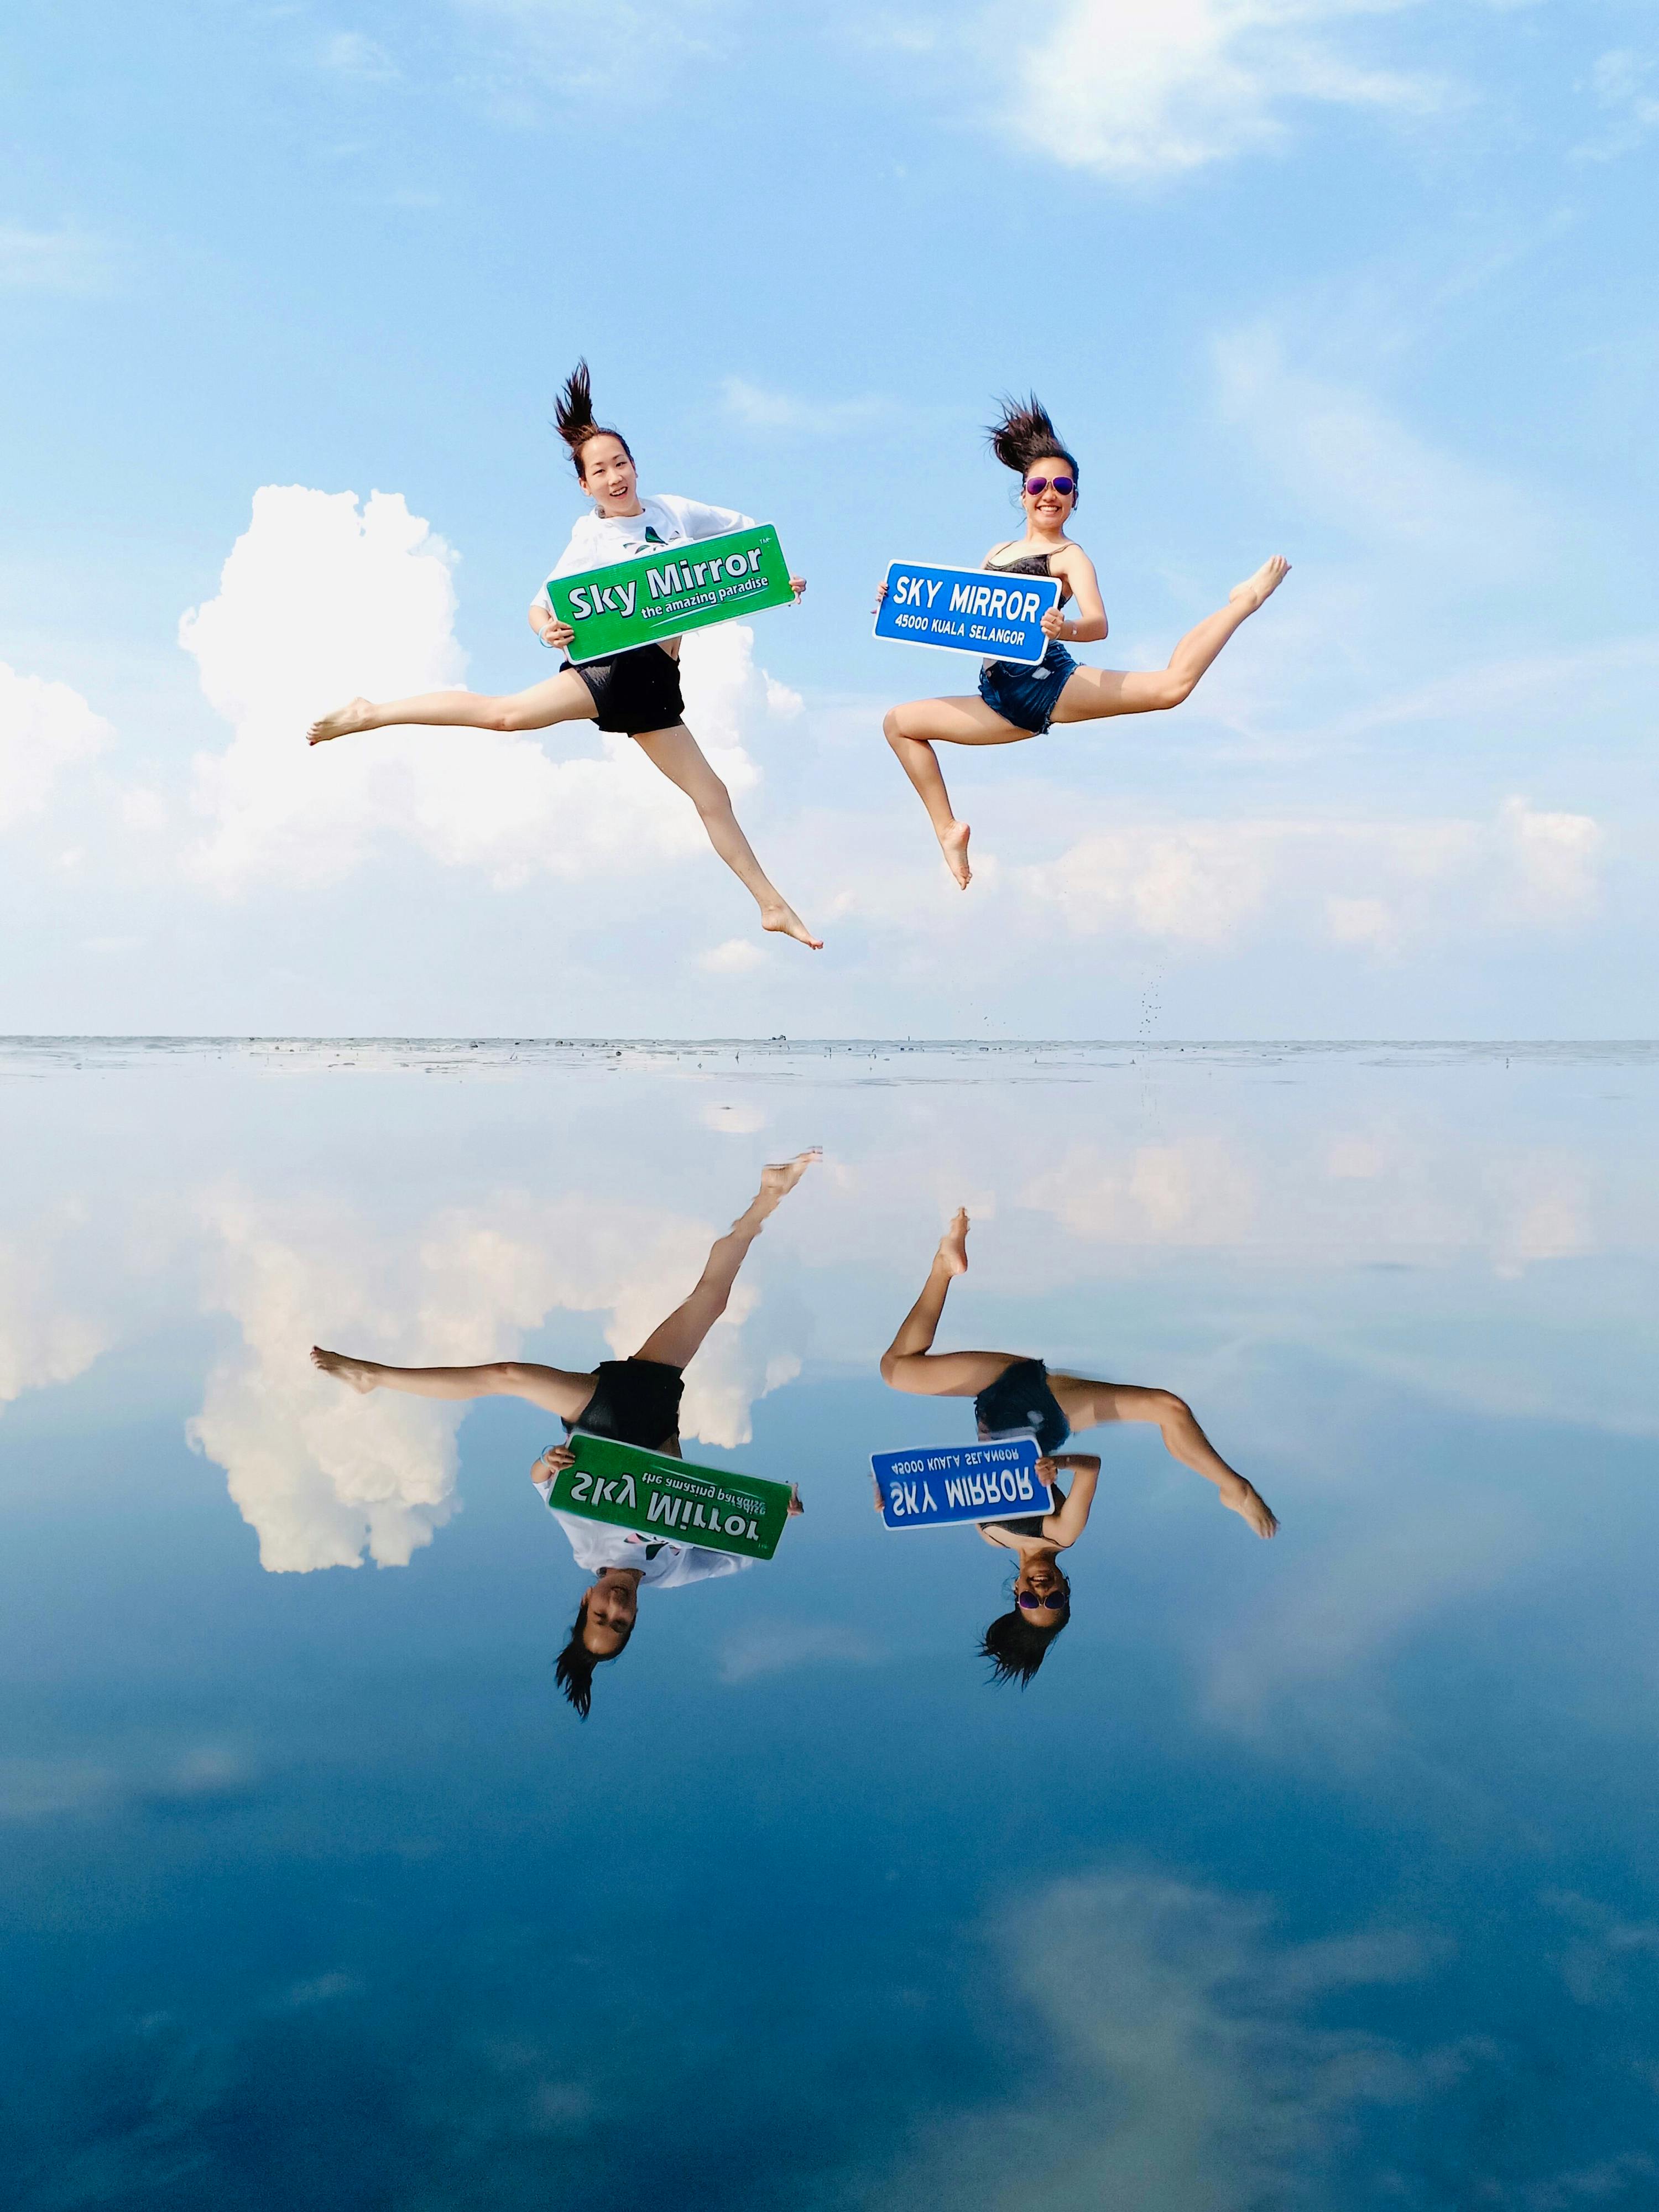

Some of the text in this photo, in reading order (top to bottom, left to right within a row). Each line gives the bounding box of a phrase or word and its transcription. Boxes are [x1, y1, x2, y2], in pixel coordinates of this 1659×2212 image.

[568, 547, 762, 620] Sky Mirror
[641, 576, 768, 619] the amazing paradise
[893, 576, 1041, 623] SKY MIRROR
[895, 614, 1025, 646] 45000 KUALA SELANGOR
